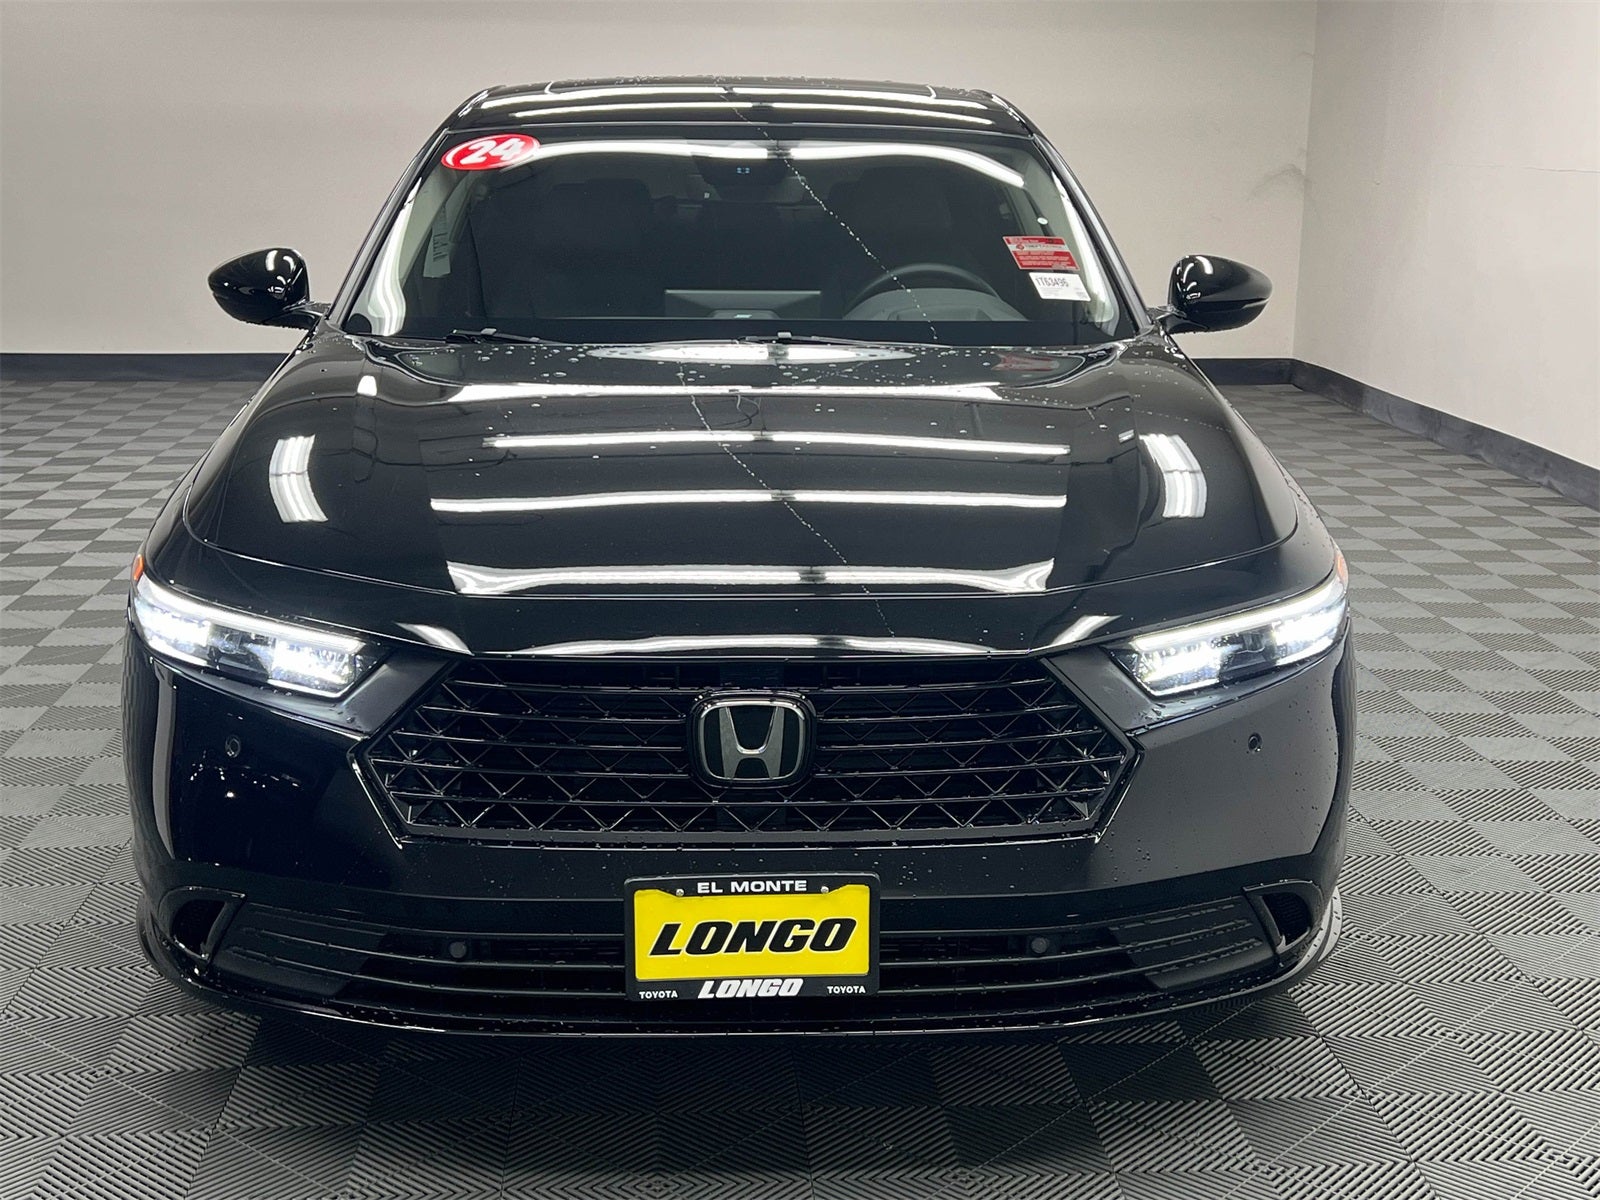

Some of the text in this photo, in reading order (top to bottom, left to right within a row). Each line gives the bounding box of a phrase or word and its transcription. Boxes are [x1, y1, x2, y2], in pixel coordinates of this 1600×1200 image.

[459, 137, 526, 165] 24
[697, 880, 807, 894] EL MONTE
[648, 917, 858, 957] LONGO
[638, 990, 679, 1000] TOYOTA
[697, 978, 804, 999] LONGO
[826, 985, 867, 995] TOYOTA
